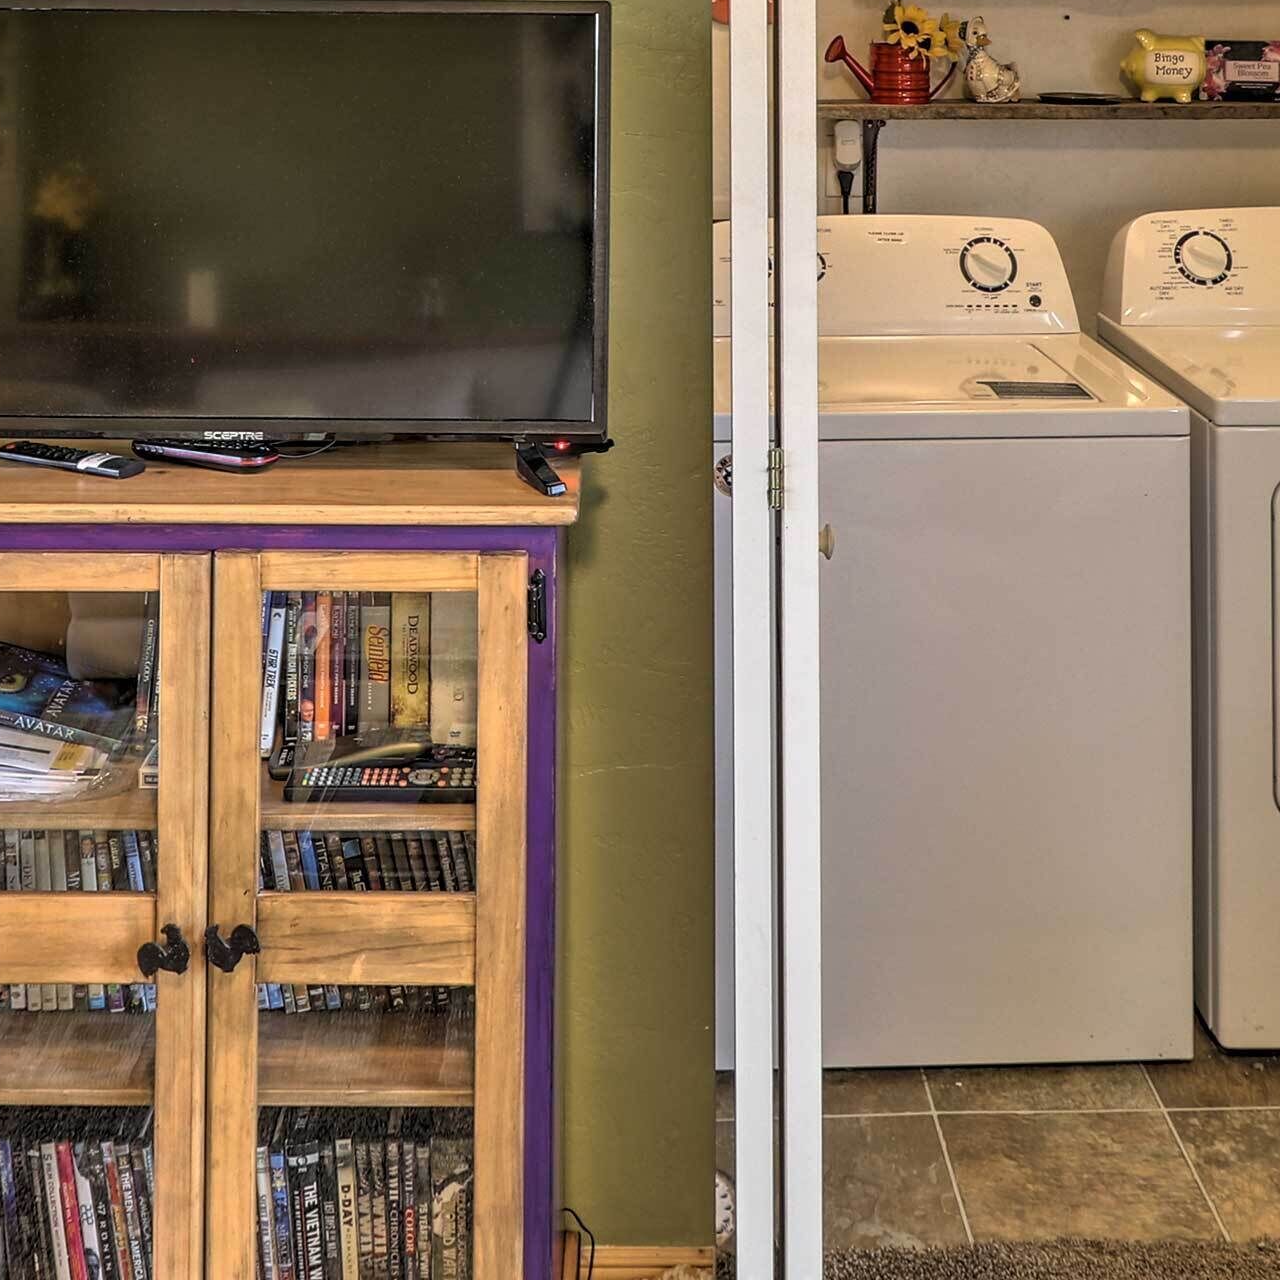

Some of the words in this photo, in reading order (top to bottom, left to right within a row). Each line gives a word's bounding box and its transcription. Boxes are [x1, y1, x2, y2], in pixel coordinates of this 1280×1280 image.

[1154, 52, 1185, 66] Bingo
[1156, 64, 1193, 80] Money
[204, 431, 264, 441] SCEPTRE
[267, 648, 278, 668] STAR
[367, 625, 390, 683] Seinfeld
[407, 615, 419, 695] DEADWOOD
[265, 669, 276, 688] TREK
[287, 673, 297, 701] PICKERS
[46, 680, 75, 718] AVATAR
[14, 717, 75, 741] AVATAR
[120, 1171, 132, 1191] THE
[303, 1181, 318, 1208] THE
[48, 1181, 59, 1228] COLLECTION
[123, 1191, 134, 1213] MEN
[340, 1184, 354, 1227] D-DAY
[99, 1220, 113, 1272] RONIN
[305, 1209, 323, 1265] VIETNAM
[390, 1209, 399, 1277] CHRONICLES
[406, 1208, 414, 1253] COLOR
[131, 1240, 143, 1280] AMERICA
